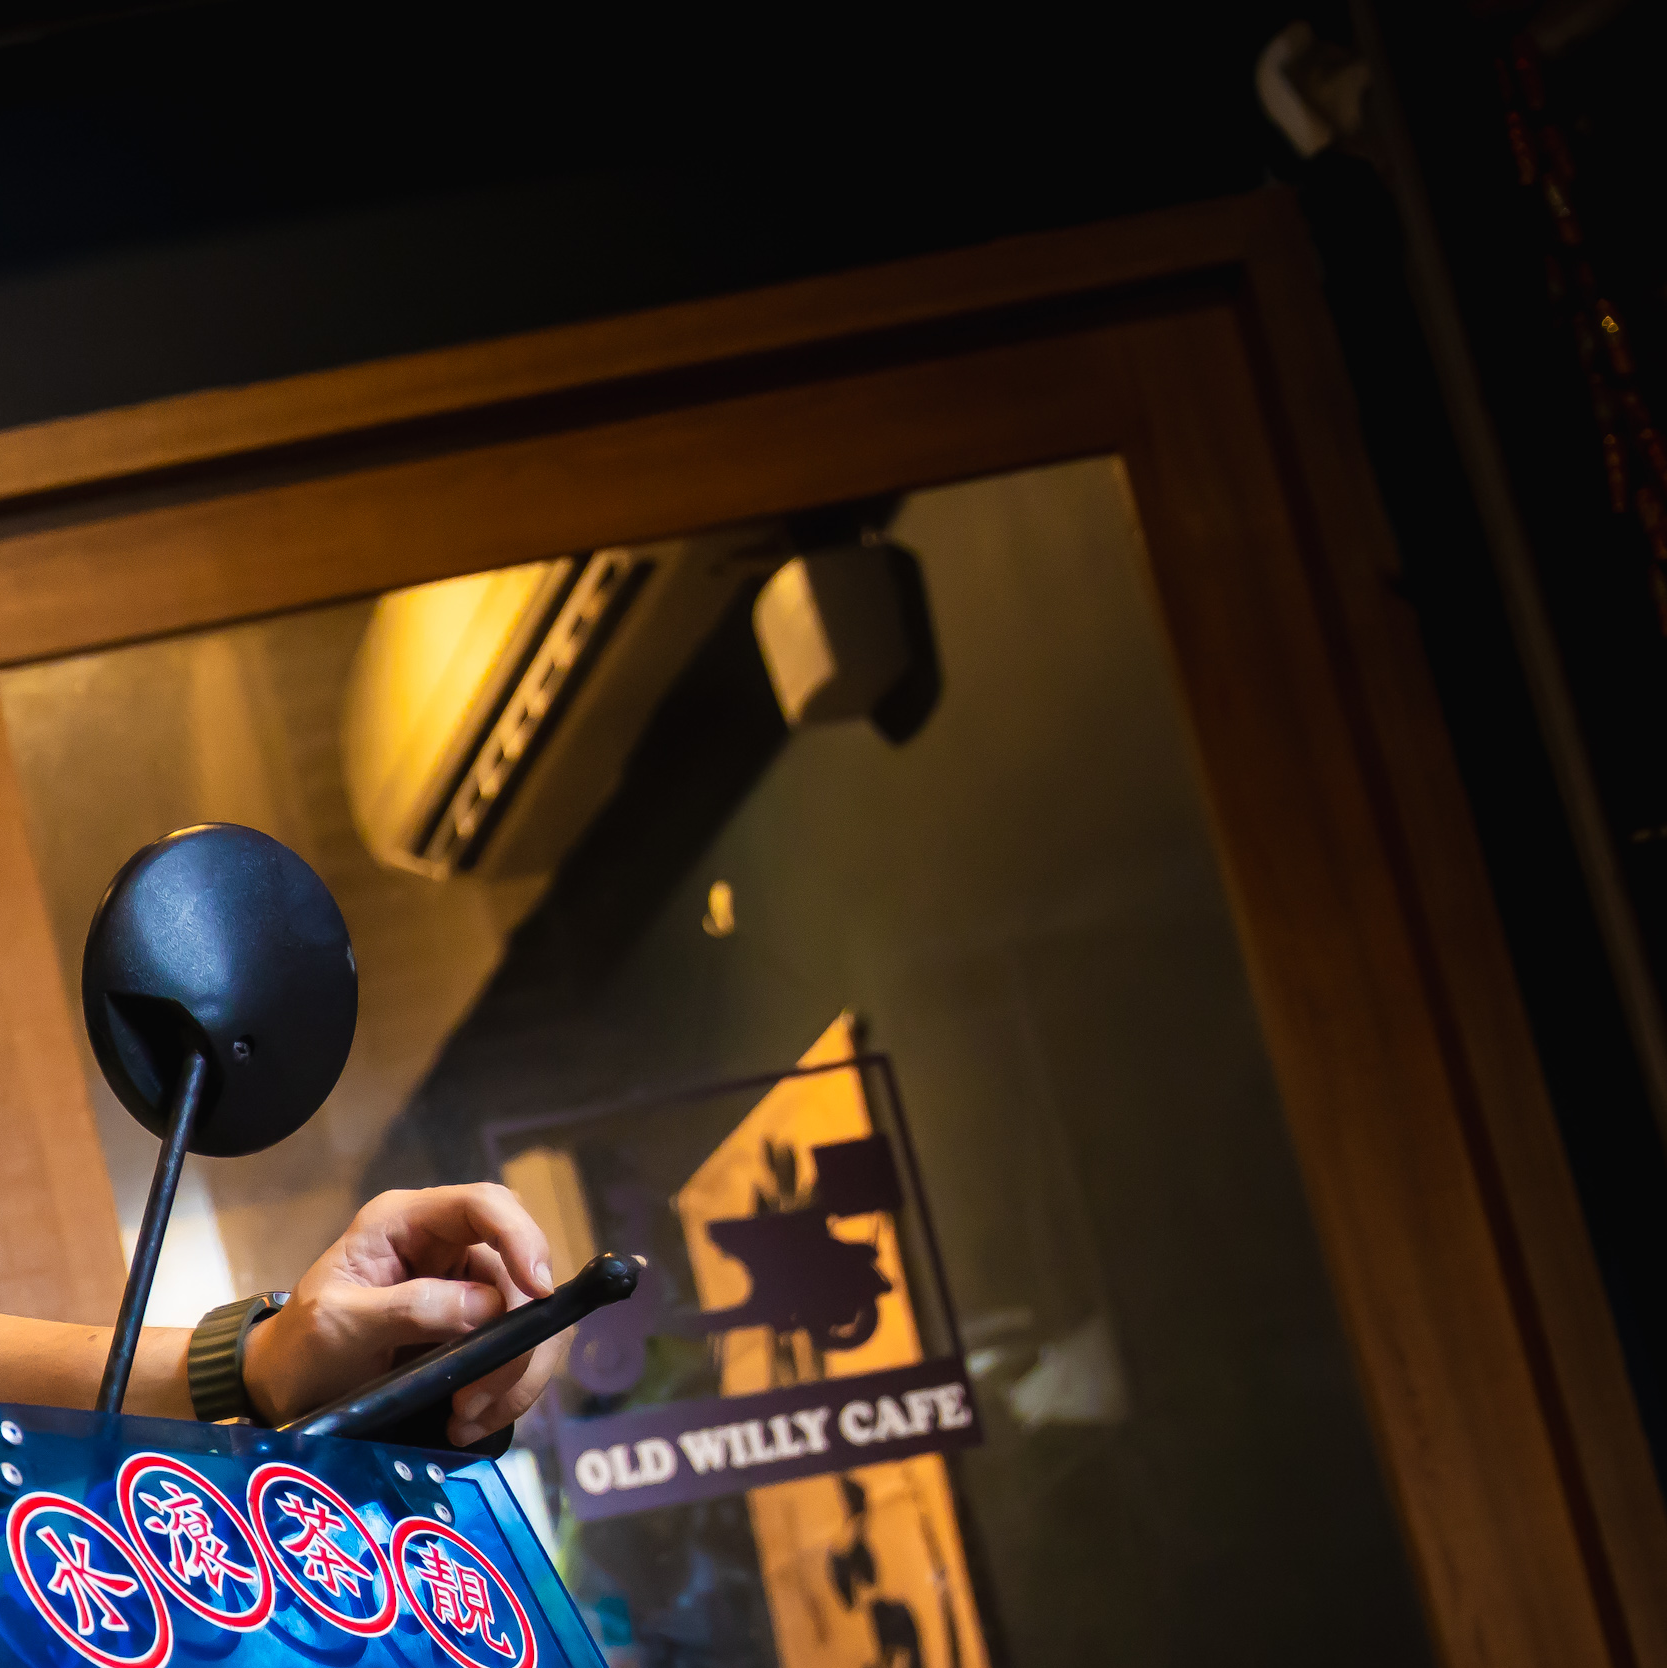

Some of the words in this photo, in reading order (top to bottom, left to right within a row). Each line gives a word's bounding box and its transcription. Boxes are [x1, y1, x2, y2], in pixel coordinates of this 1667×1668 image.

[575, 1437, 677, 1495] OLD
[678, 1406, 833, 1475] WILLY
[838, 1382, 973, 1446] CAFE
[36, 1479, 516, 1659] 水滾茶靚
